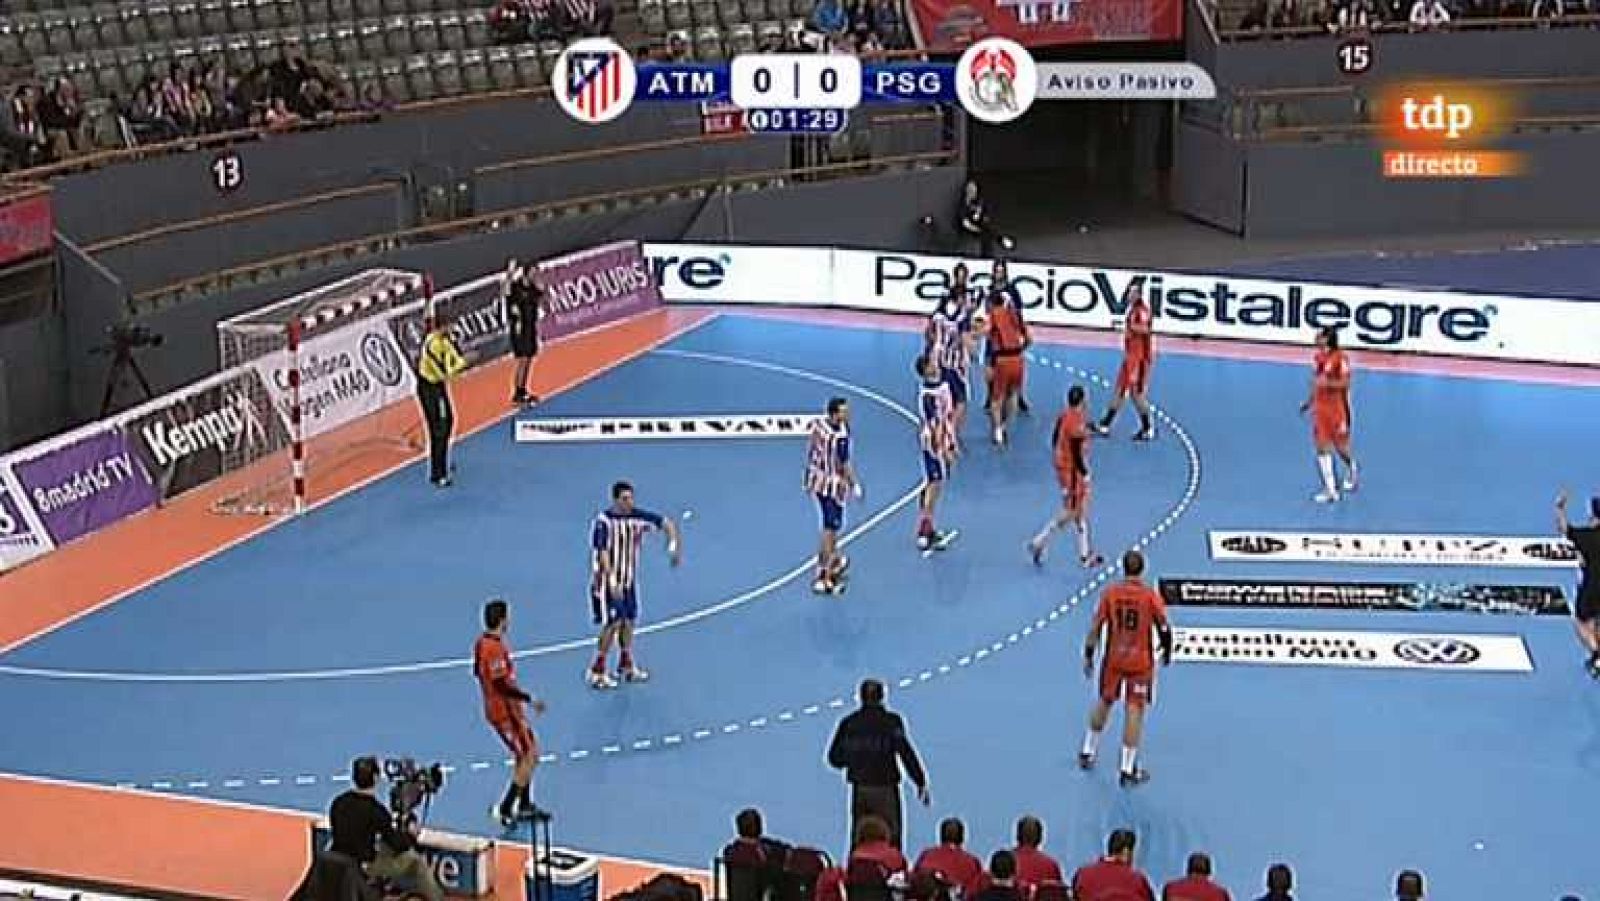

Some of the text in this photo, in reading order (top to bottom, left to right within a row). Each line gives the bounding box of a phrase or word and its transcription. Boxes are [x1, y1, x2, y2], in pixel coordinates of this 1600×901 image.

[1339, 45, 1370, 71] 15
[213, 158, 241, 189] 13
[652, 255, 731, 290] re
[107, 451, 134, 478] TV
